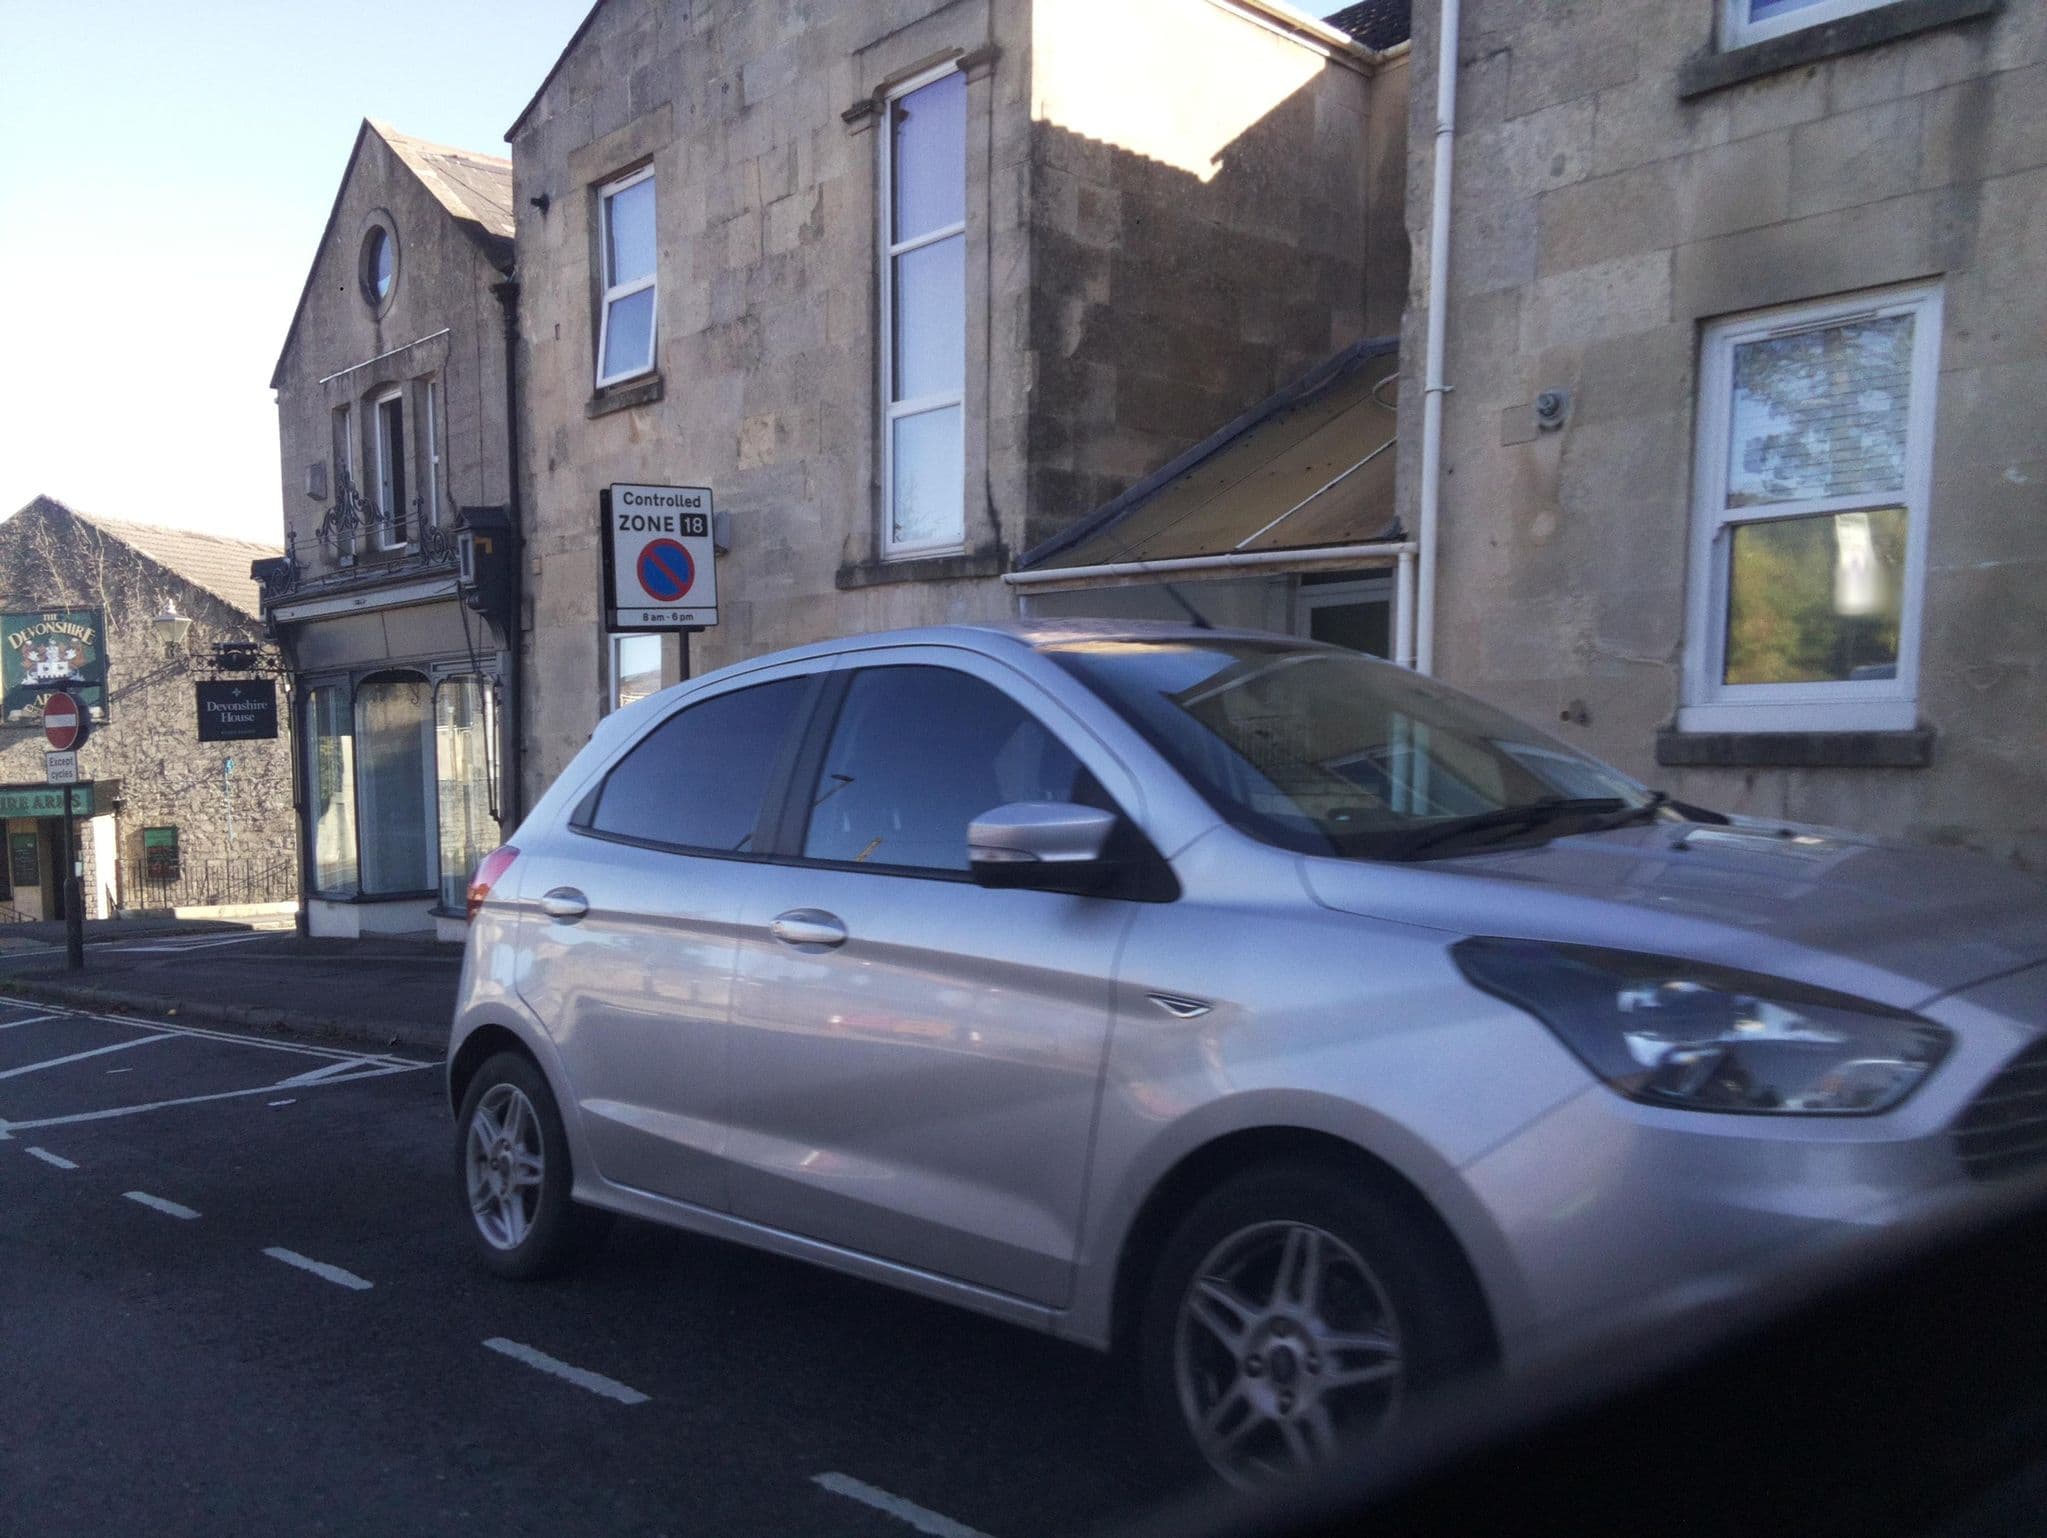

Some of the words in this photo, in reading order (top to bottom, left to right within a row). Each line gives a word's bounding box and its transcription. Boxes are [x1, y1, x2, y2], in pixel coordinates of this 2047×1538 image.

[623, 491, 701, 508] Controlled
[618, 514, 675, 532] ZONE
[684, 517, 704, 534] 18
[43, 613, 58, 621] THE
[8, 621, 96, 650] DEVONSHIRE
[206, 699, 268, 712] Devonshire
[221, 711, 255, 723] House
[49, 756, 74, 767] Except
[51, 769, 73, 780] cycles
